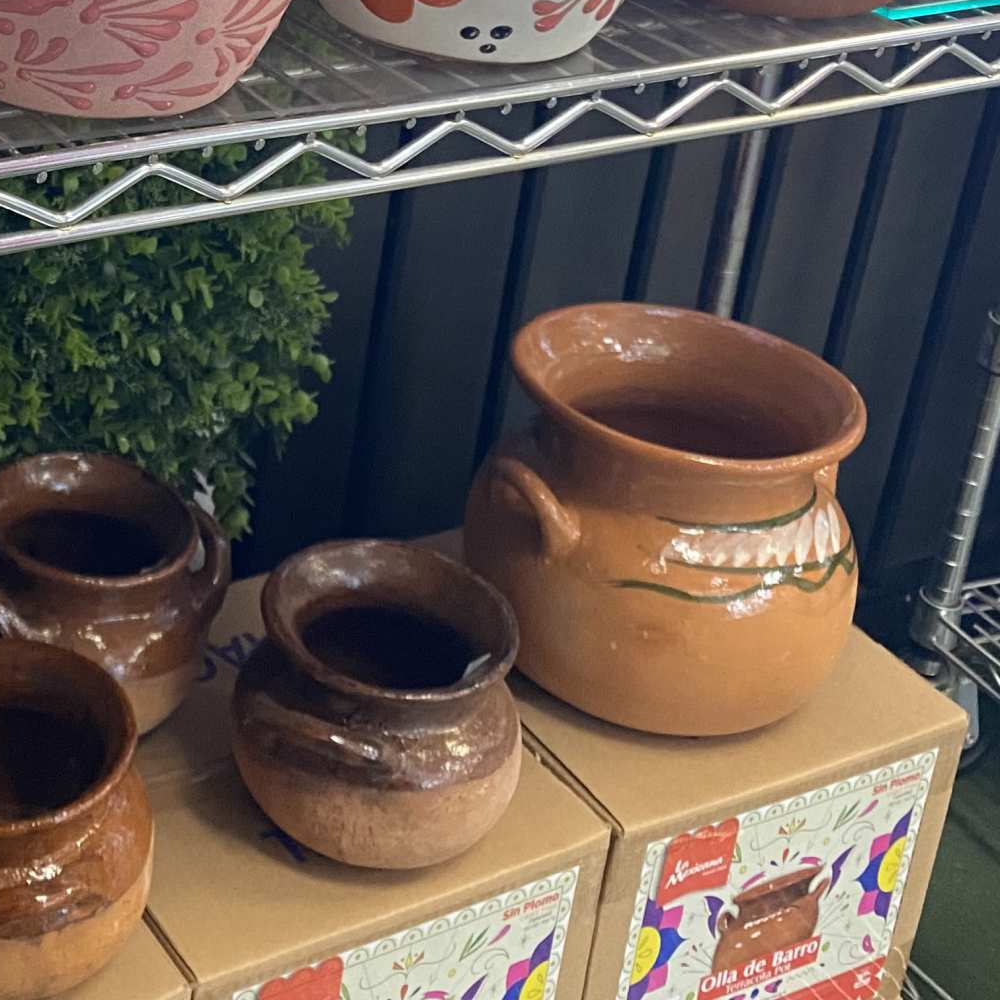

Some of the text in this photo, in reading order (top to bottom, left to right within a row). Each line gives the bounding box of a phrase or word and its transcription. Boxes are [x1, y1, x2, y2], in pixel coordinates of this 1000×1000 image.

[503, 907, 521, 921] Sin
[523, 892, 560, 913] Plomo
[700, 940, 819, 993] Olla de Barro
